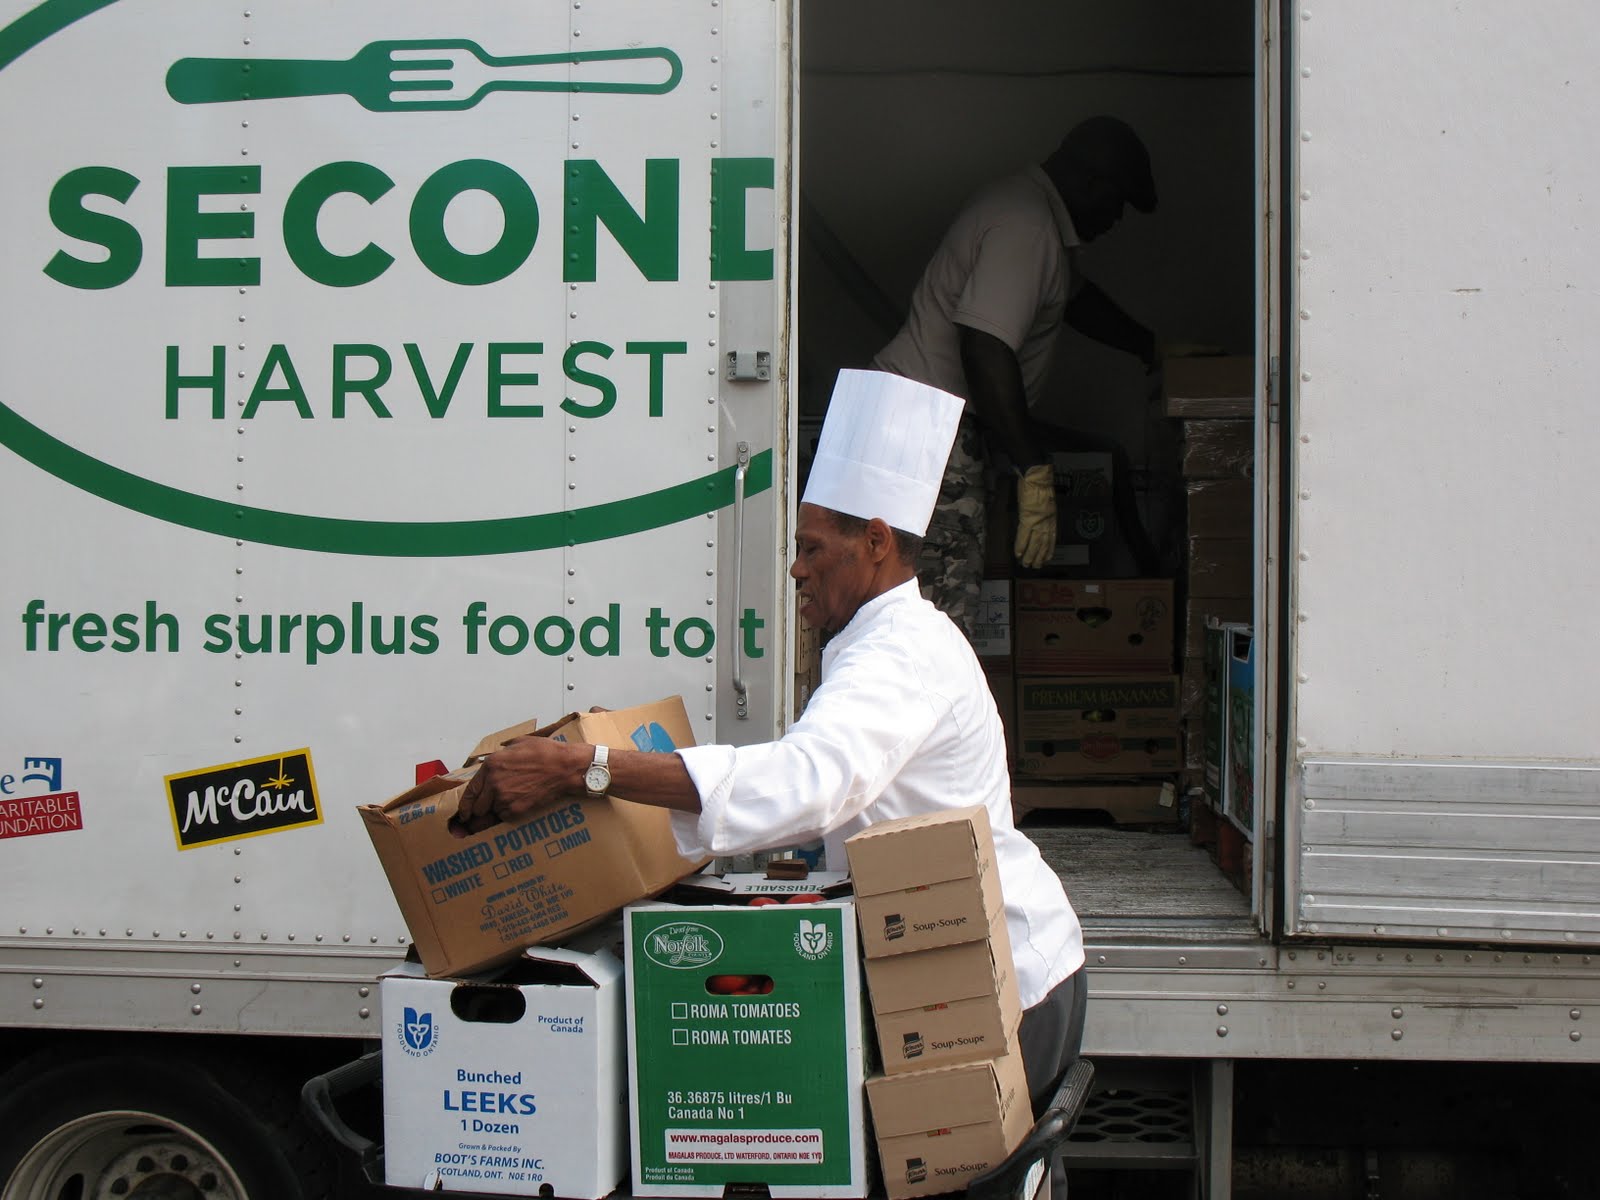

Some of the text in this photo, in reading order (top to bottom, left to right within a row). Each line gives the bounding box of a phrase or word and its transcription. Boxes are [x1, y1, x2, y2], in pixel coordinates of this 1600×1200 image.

[42, 157, 774, 290] SECOND
[165, 341, 687, 419] HARVEST
[22, 599, 179, 653] fresh
[203, 601, 439, 665] surplus
[463, 601, 620, 656] food
[646, 608, 715, 658] to
[1031, 687, 1168, 704] PREMIUM BANANAS
[181, 777, 314, 833] McCain
[422, 803, 585, 885] WASHED POTATOES
[445, 828, 591, 899] WHITE RED MINI
[481, 883, 566, 920] David White
[653, 934, 710, 965] Norfolk
[793, 932, 833, 960] FOODLAND ONTARIO
[691, 1003, 800, 1018] ROMA TOMATOES
[538, 1015, 584, 1024] Product of
[550, 1024, 583, 1033] Canada
[692, 1029, 792, 1044] ROMA TOMATES
[397, 1023, 439, 1058] FOODLAND ONTARIO
[457, 1069, 522, 1084] Bunched
[443, 1090, 537, 1115] LEEKS
[667, 1091, 792, 1105] 36.36875 litres/1 Bu
[668, 1107, 745, 1119] Canada No 1
[460, 1119, 519, 1134] 1 Dozen
[671, 1133, 819, 1145] www.magalasproduce.com
[488, 1144, 512, 1152] Packed
[695, 1152, 723, 1160] PRODUCE,
[724, 1152, 734, 1160] LTD
[735, 1152, 772, 1160] WATERFORD,
[773, 1152, 797, 1160] ONTARIO
[434, 1153, 545, 1169] BOOT'S FARMS INC.
[436, 1167, 483, 1178] SCOTLAND,
[484, 1170, 503, 1179] ONT.
